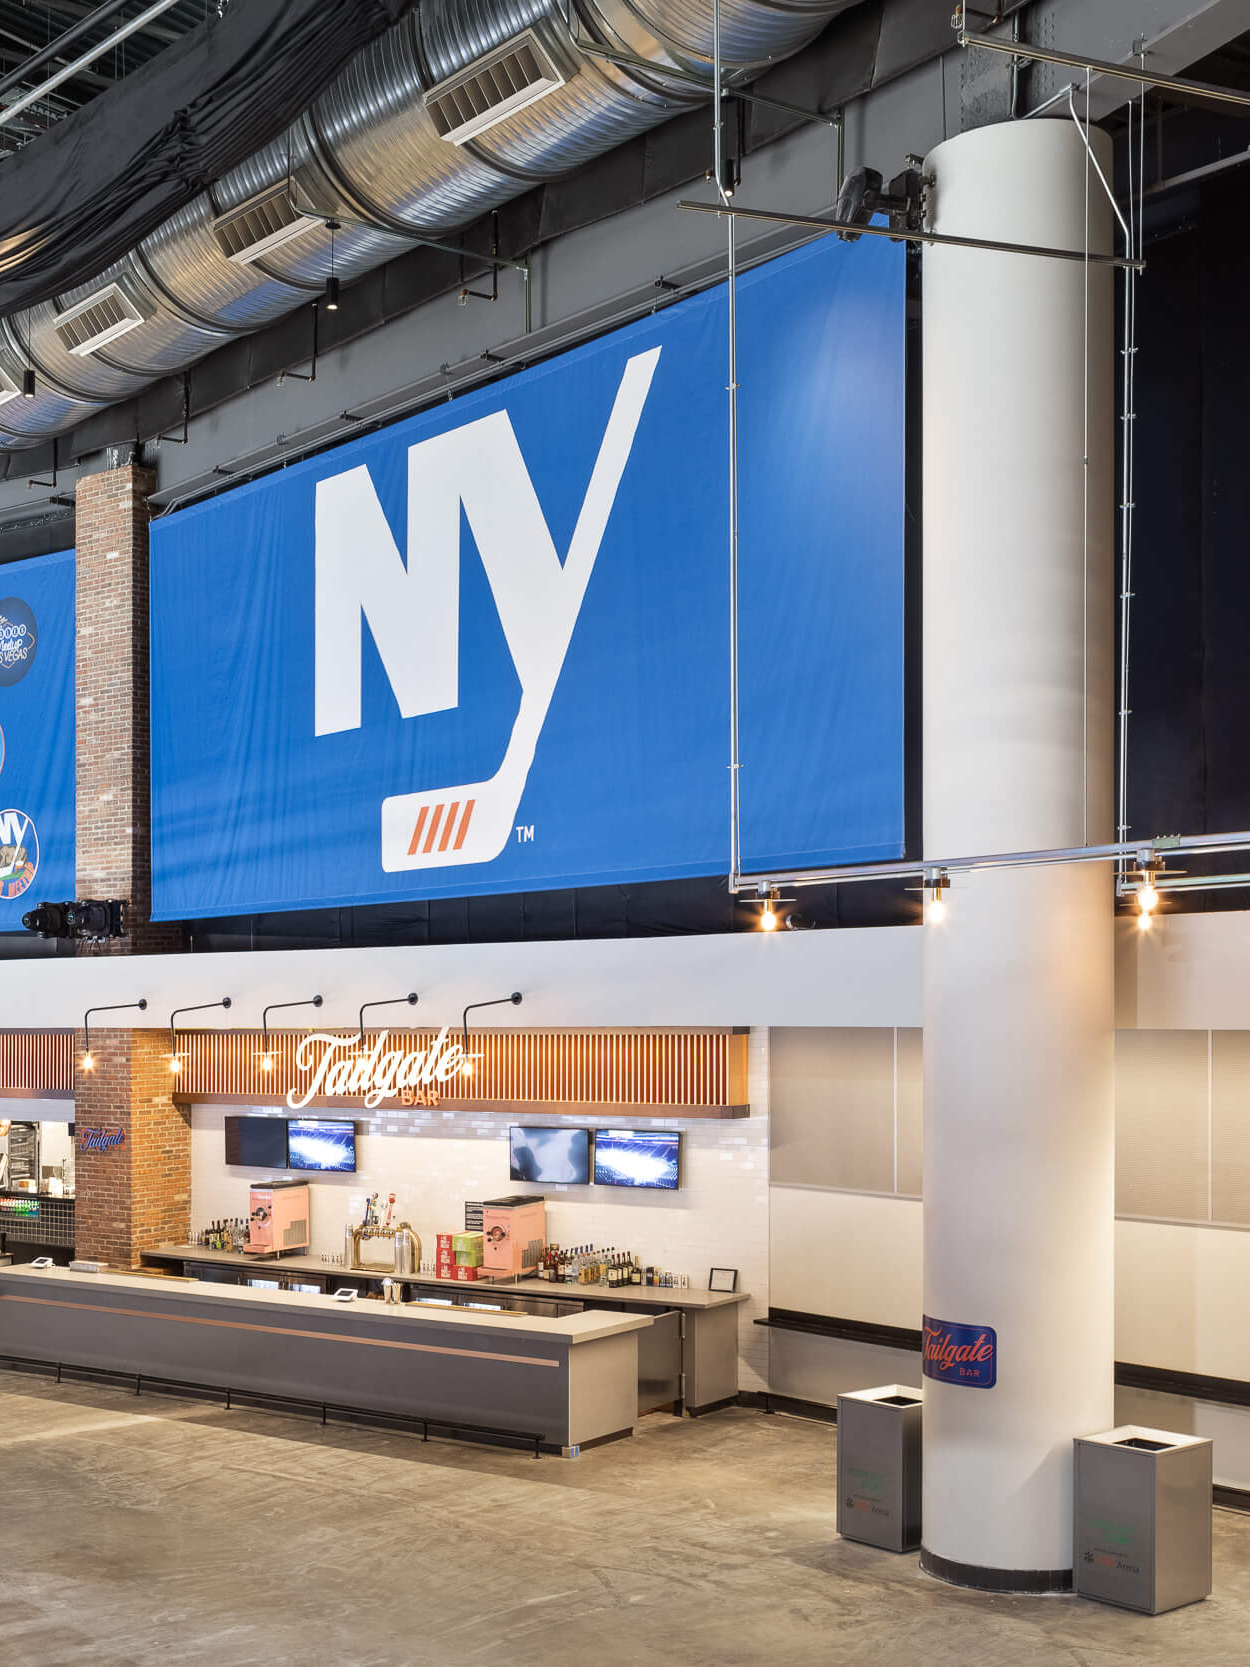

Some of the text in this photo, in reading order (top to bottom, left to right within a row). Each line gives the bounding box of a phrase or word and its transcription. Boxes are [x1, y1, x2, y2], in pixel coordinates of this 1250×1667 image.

[315, 345, 662, 872] NY
[4, 647, 28, 662] VEGAS
[515, 825, 535, 844] TM
[286, 1026, 465, 1110] Tailgate
[401, 1090, 439, 1107] BAR
[79, 1128, 125, 1152] Tailgate
[924, 1325, 994, 1371] Tailgate
[959, 1367, 981, 1377] BAR
